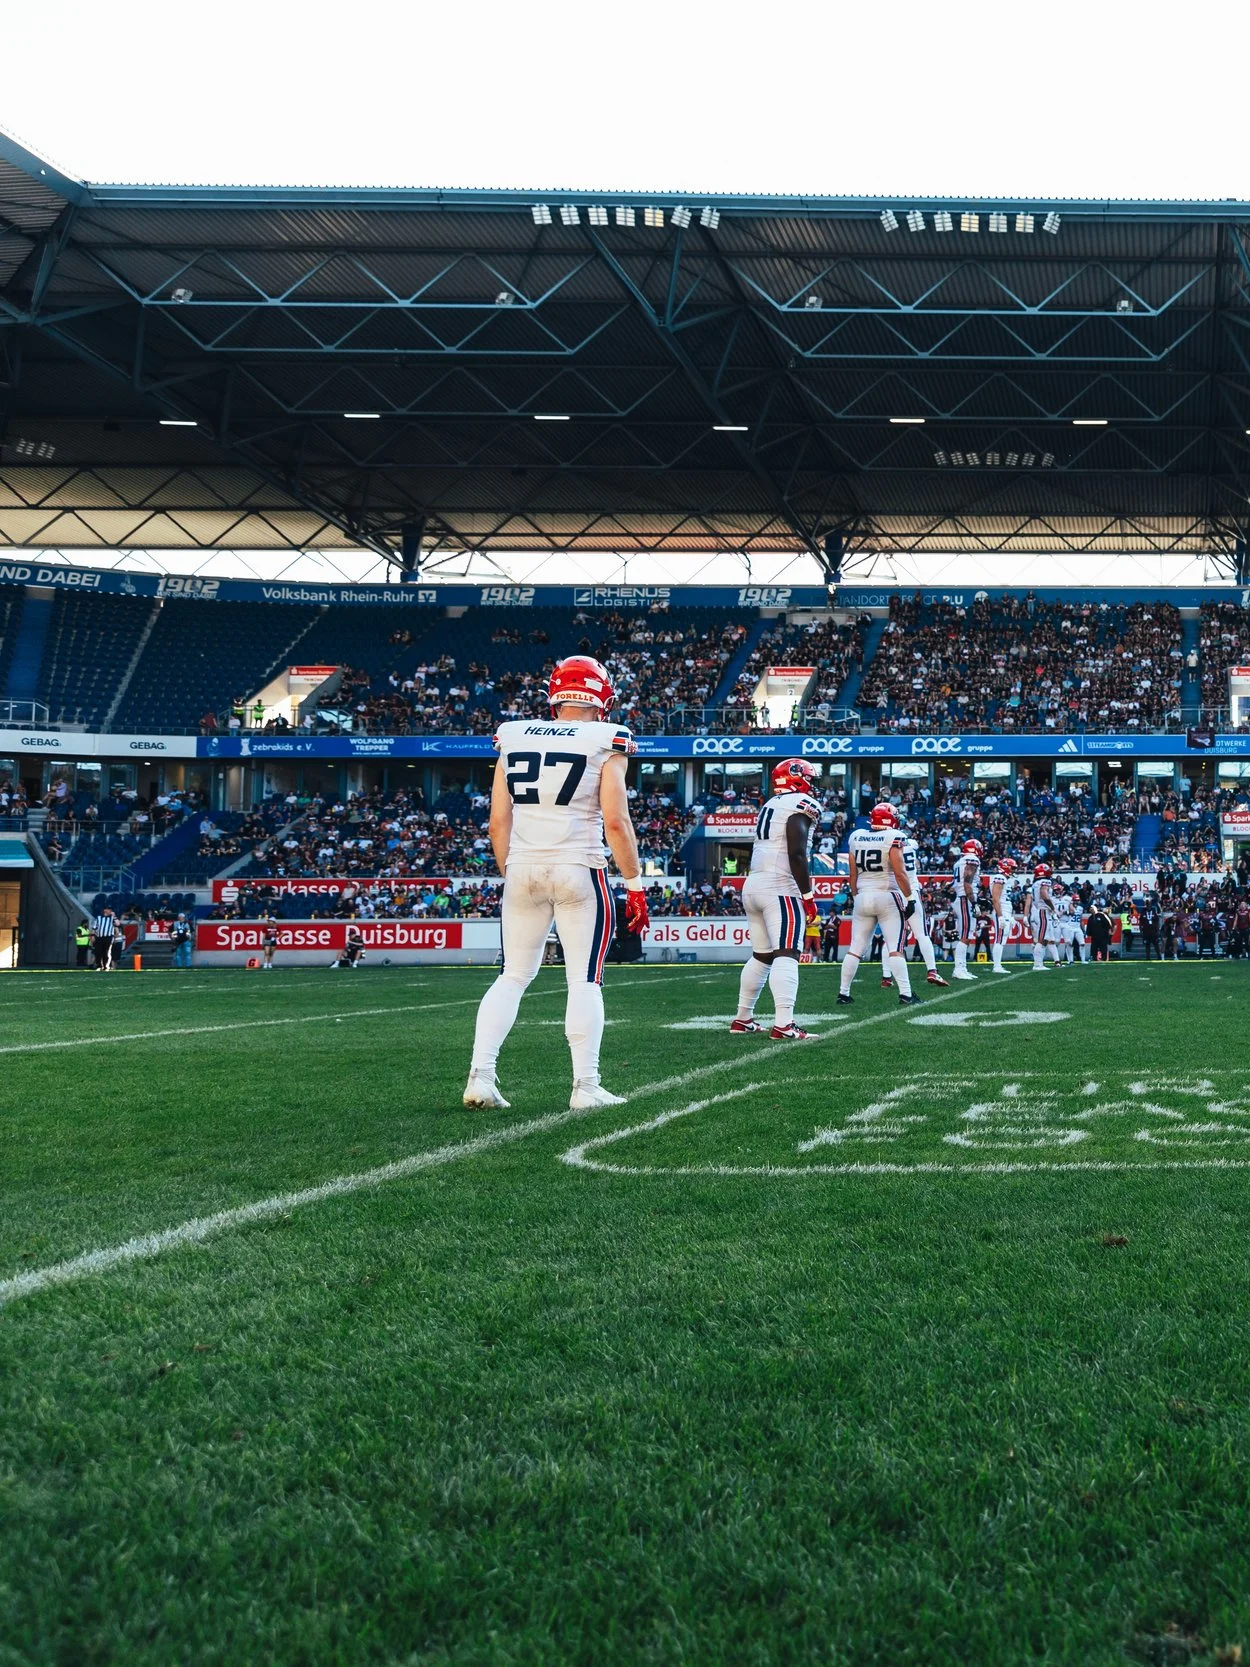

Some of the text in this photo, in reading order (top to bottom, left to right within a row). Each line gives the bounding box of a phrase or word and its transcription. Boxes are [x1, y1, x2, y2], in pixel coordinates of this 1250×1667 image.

[0, 566, 101, 588] ND DABEI
[157, 578, 220, 595] 1902
[481, 587, 536, 601] 1902
[594, 588, 671, 598] RHENUS
[262, 587, 415, 603] Volksbank Rhein-Ruhr
[594, 599, 670, 607] LOGISTI
[738, 588, 792, 602] 1902
[556, 693, 595, 703] FORELLE
[524, 726, 578, 737] HEINZE
[253, 743, 294, 752] zebrakids
[692, 738, 744, 755] pape
[802, 738, 853, 755] pape
[911, 738, 962, 755] pape
[507, 752, 587, 806] 27
[716, 814, 753, 824] Sparkasse
[855, 849, 884, 872] 42
[216, 924, 447, 950] Sparasse Duisburg
[654, 924, 680, 942] als
[686, 924, 726, 942] Geld
